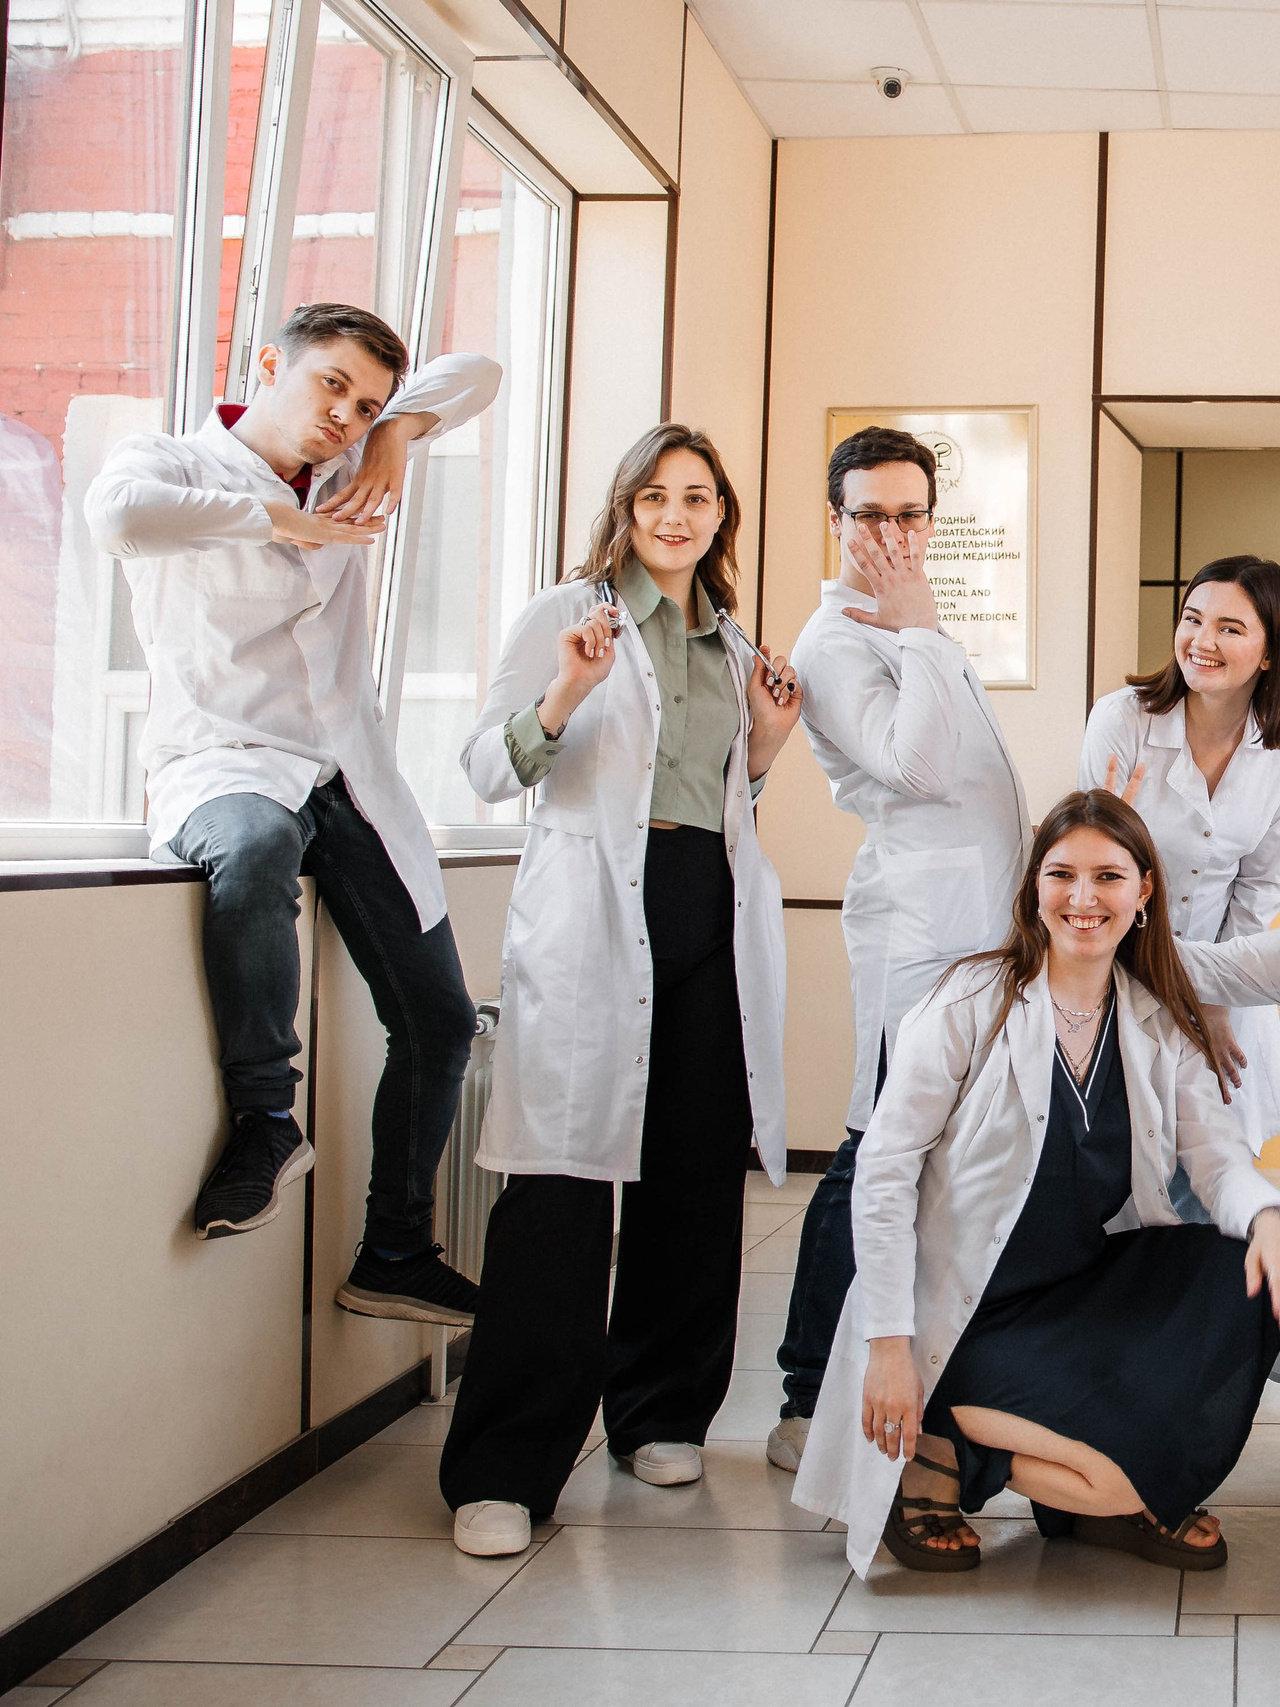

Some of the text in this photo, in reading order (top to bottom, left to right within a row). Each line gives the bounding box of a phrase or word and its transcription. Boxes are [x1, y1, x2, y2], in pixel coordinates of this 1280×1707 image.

[934, 513, 976, 525] РОДНЫЙ
[934, 526, 1005, 537] ОВАТЕЛЬСКИЙ
[927, 538, 1003, 549] АЗОВАТЕЛЬНЫЙ
[926, 551, 1020, 561] ИВНОЙ МЕДИЦИНЫ
[928, 577, 967, 585] ATIONAL
[933, 589, 991, 597] LINICAL AND
[937, 613, 1018, 621] RATIVE MEDICINE
